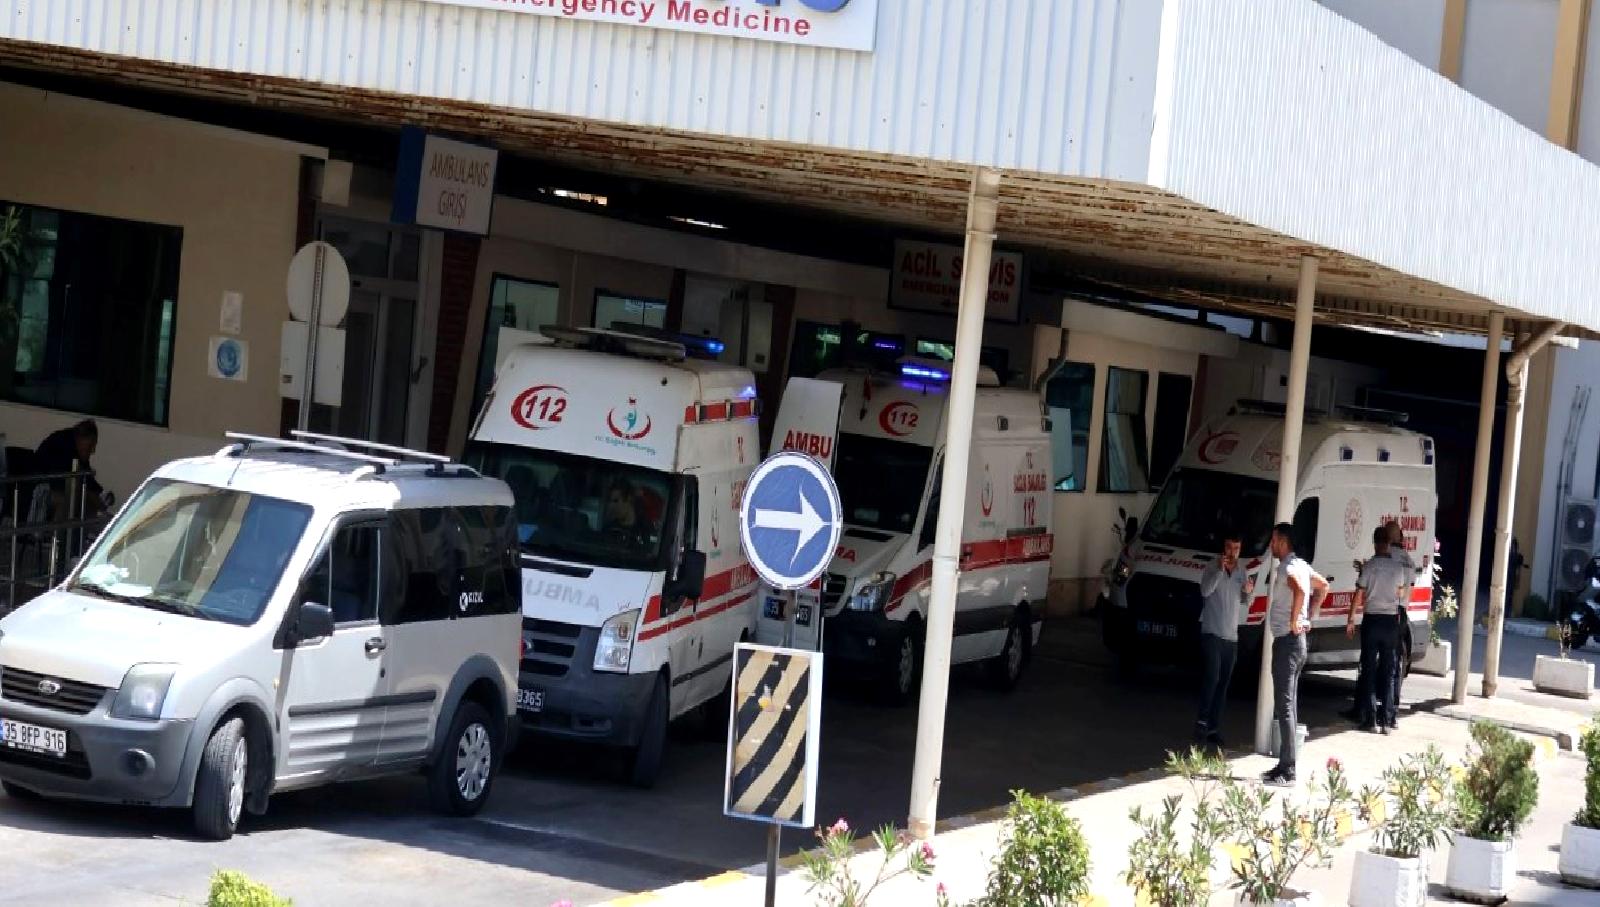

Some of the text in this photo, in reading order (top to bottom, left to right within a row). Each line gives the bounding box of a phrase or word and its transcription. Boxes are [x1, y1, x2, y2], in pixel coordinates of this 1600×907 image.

[494, 0, 655, 23] gency
[667, 0, 811, 36] Medicine
[430, 152, 490, 188] AMBULANS
[901, 248, 1015, 286] ACİL SVİS
[525, 395, 567, 422] 112
[891, 411, 919, 428] 112
[783, 430, 832, 459] AMBU
[4, 722, 17, 740] 35
[44, 730, 64, 751] 916
